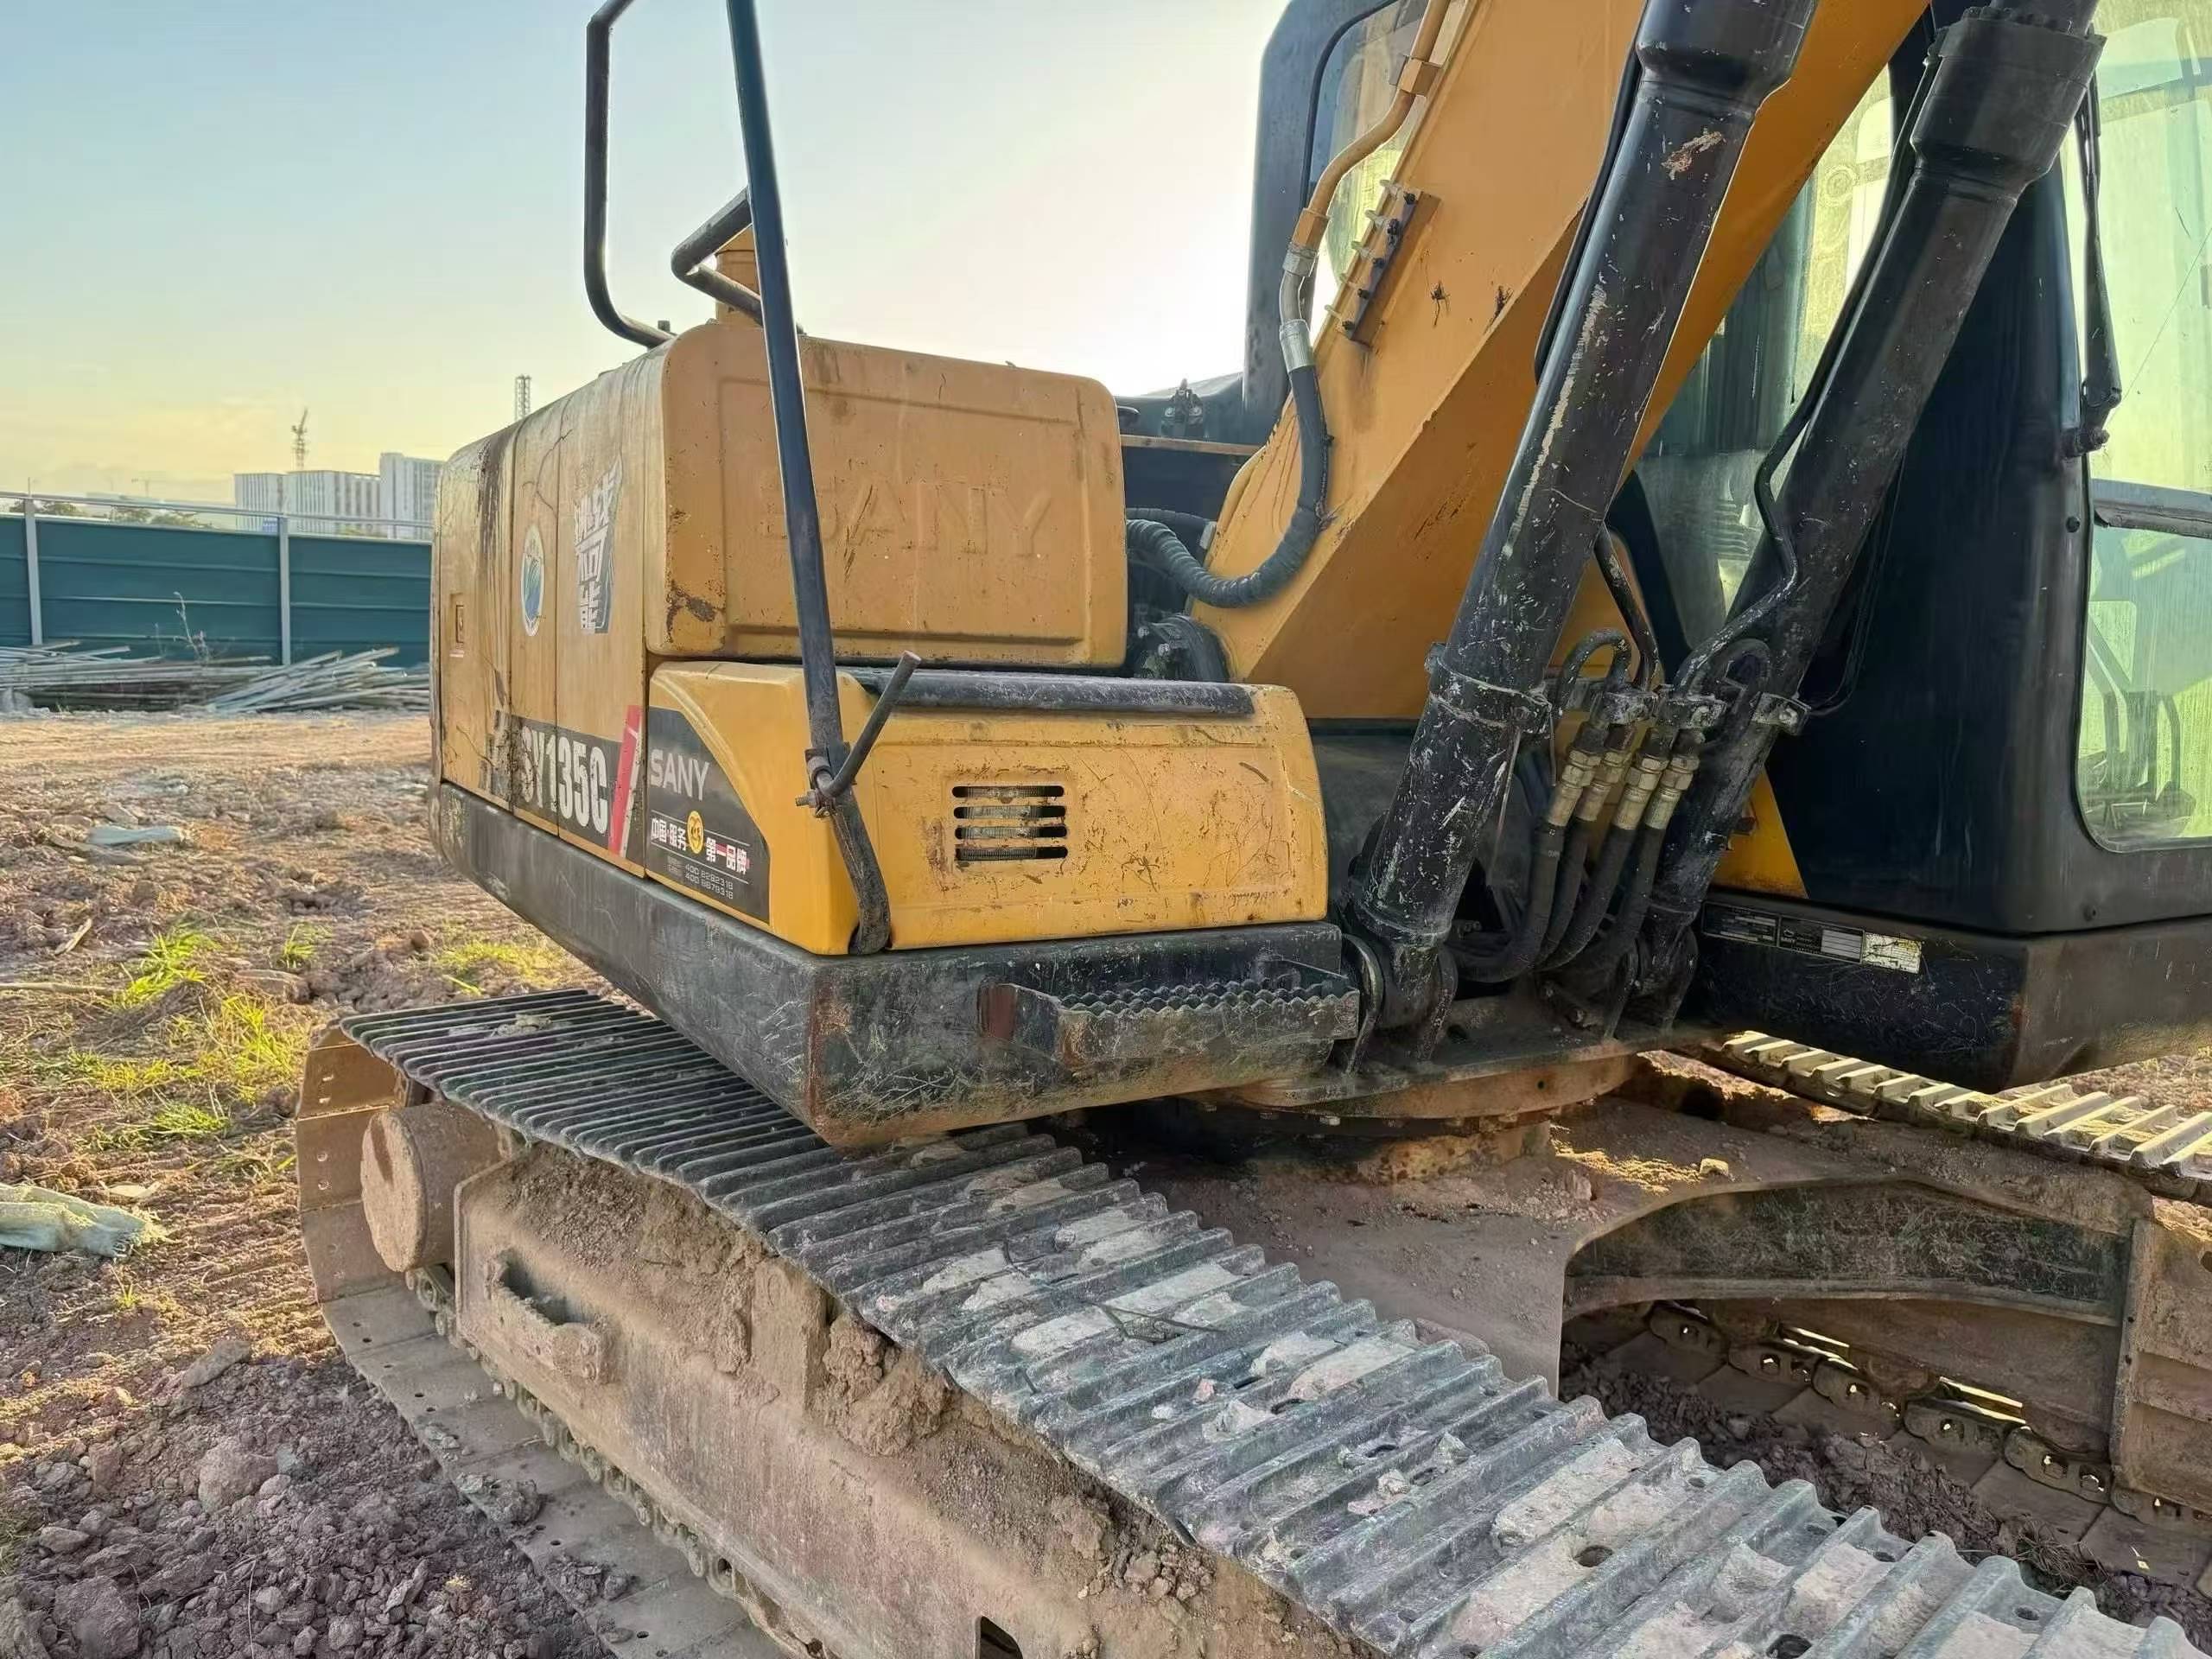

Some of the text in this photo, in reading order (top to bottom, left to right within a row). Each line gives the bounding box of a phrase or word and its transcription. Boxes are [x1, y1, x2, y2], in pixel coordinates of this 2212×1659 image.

[521, 725, 608, 835] SY135C
[649, 748, 709, 802] SANY
[705, 836, 748, 875] 第一品牌
